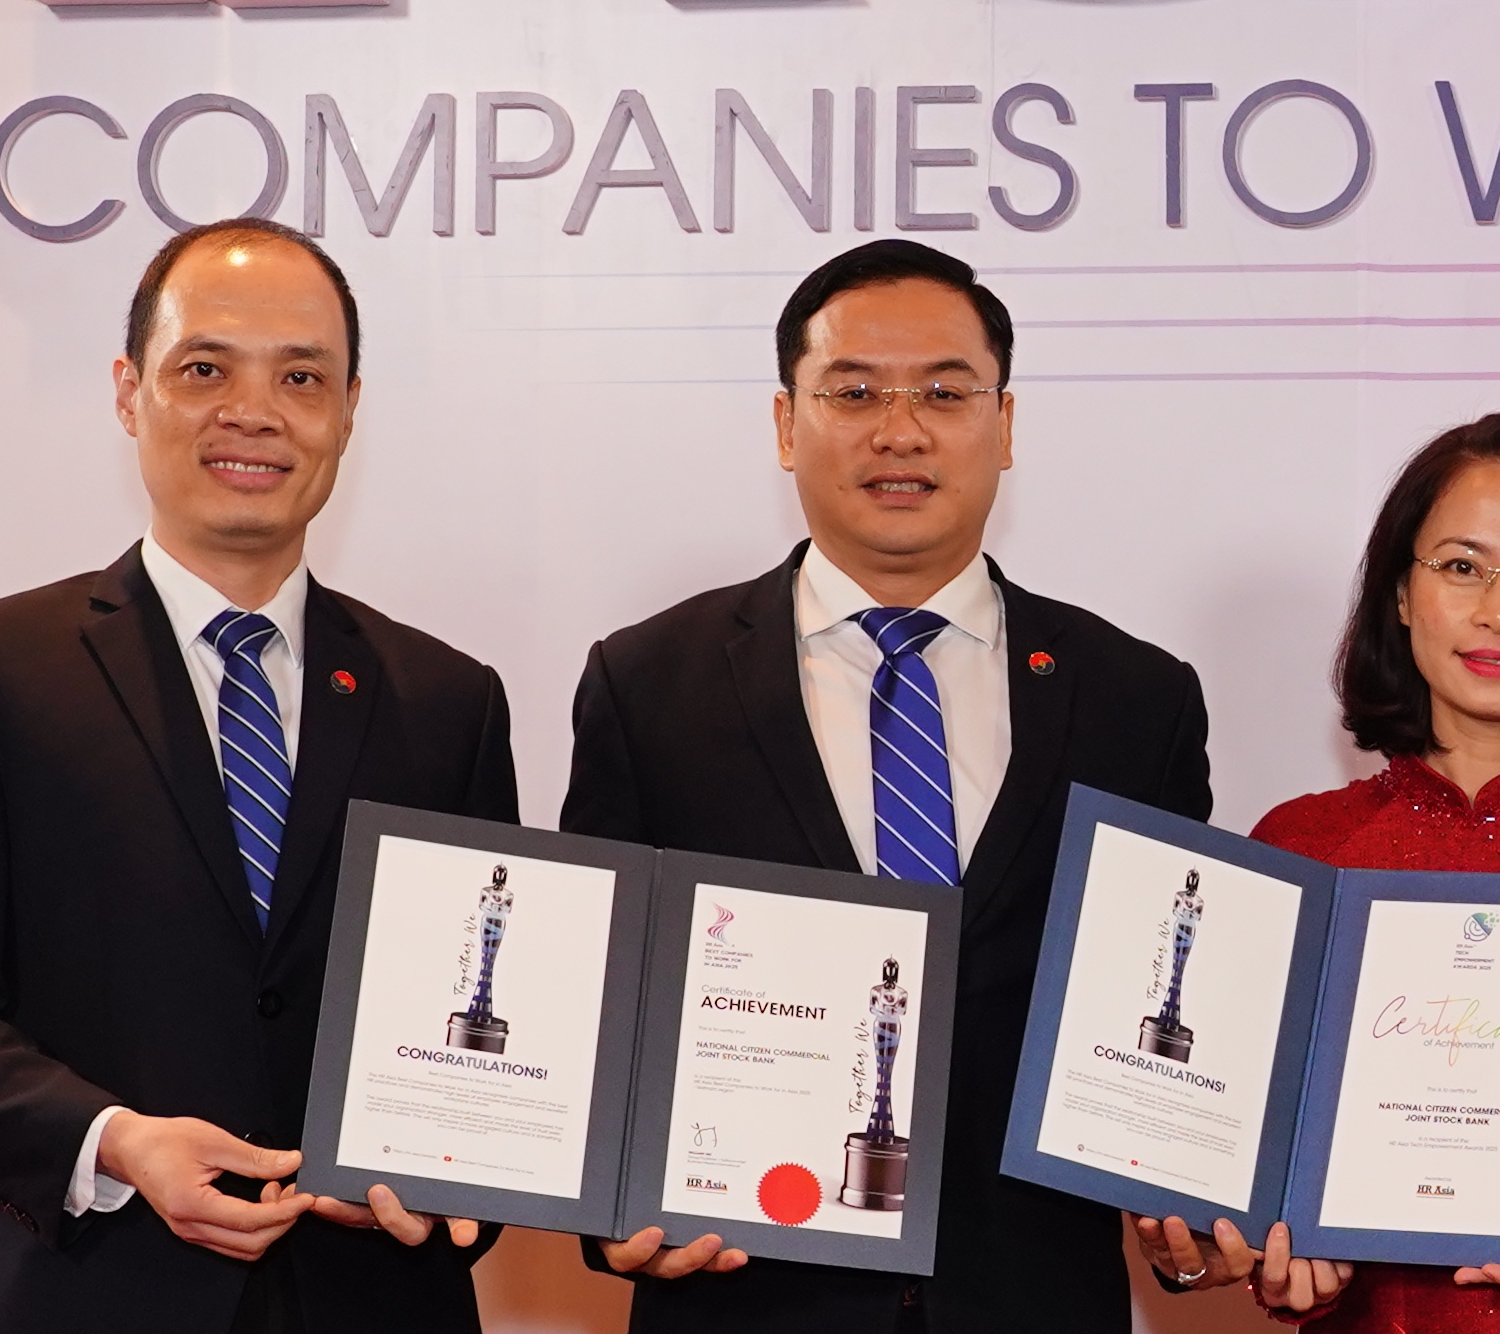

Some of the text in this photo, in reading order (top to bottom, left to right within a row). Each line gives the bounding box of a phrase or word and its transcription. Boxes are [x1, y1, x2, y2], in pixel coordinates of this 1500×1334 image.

[1133, 78, 1375, 230] TO
[453, 912, 477, 996] Together We
[1146, 917, 1171, 1001] Together We
[701, 984, 766, 999] Certificate of
[701, 995, 827, 1020] ACHIEVEMENT
[696, 1041, 830, 1061] NATIONAL CITIZEN COMMERCIAL
[1423, 1038, 1495, 1050] of Achievement
[397, 1045, 548, 1080] CONGRATULATIONS!
[696, 1051, 775, 1064] JOINT STOCK BANK
[848, 1018, 873, 1114] Together We
[1094, 1045, 1226, 1094] CONGRATULATIONS!
[1378, 1102, 1422, 1112] NATIONAL
[1425, 1105, 1457, 1113] CITIZEN
[1405, 1114, 1490, 1126] JOINT STOCK BANK
[686, 1177, 728, 1191] HR Asia
[1417, 1184, 1455, 1195] HR Asia
